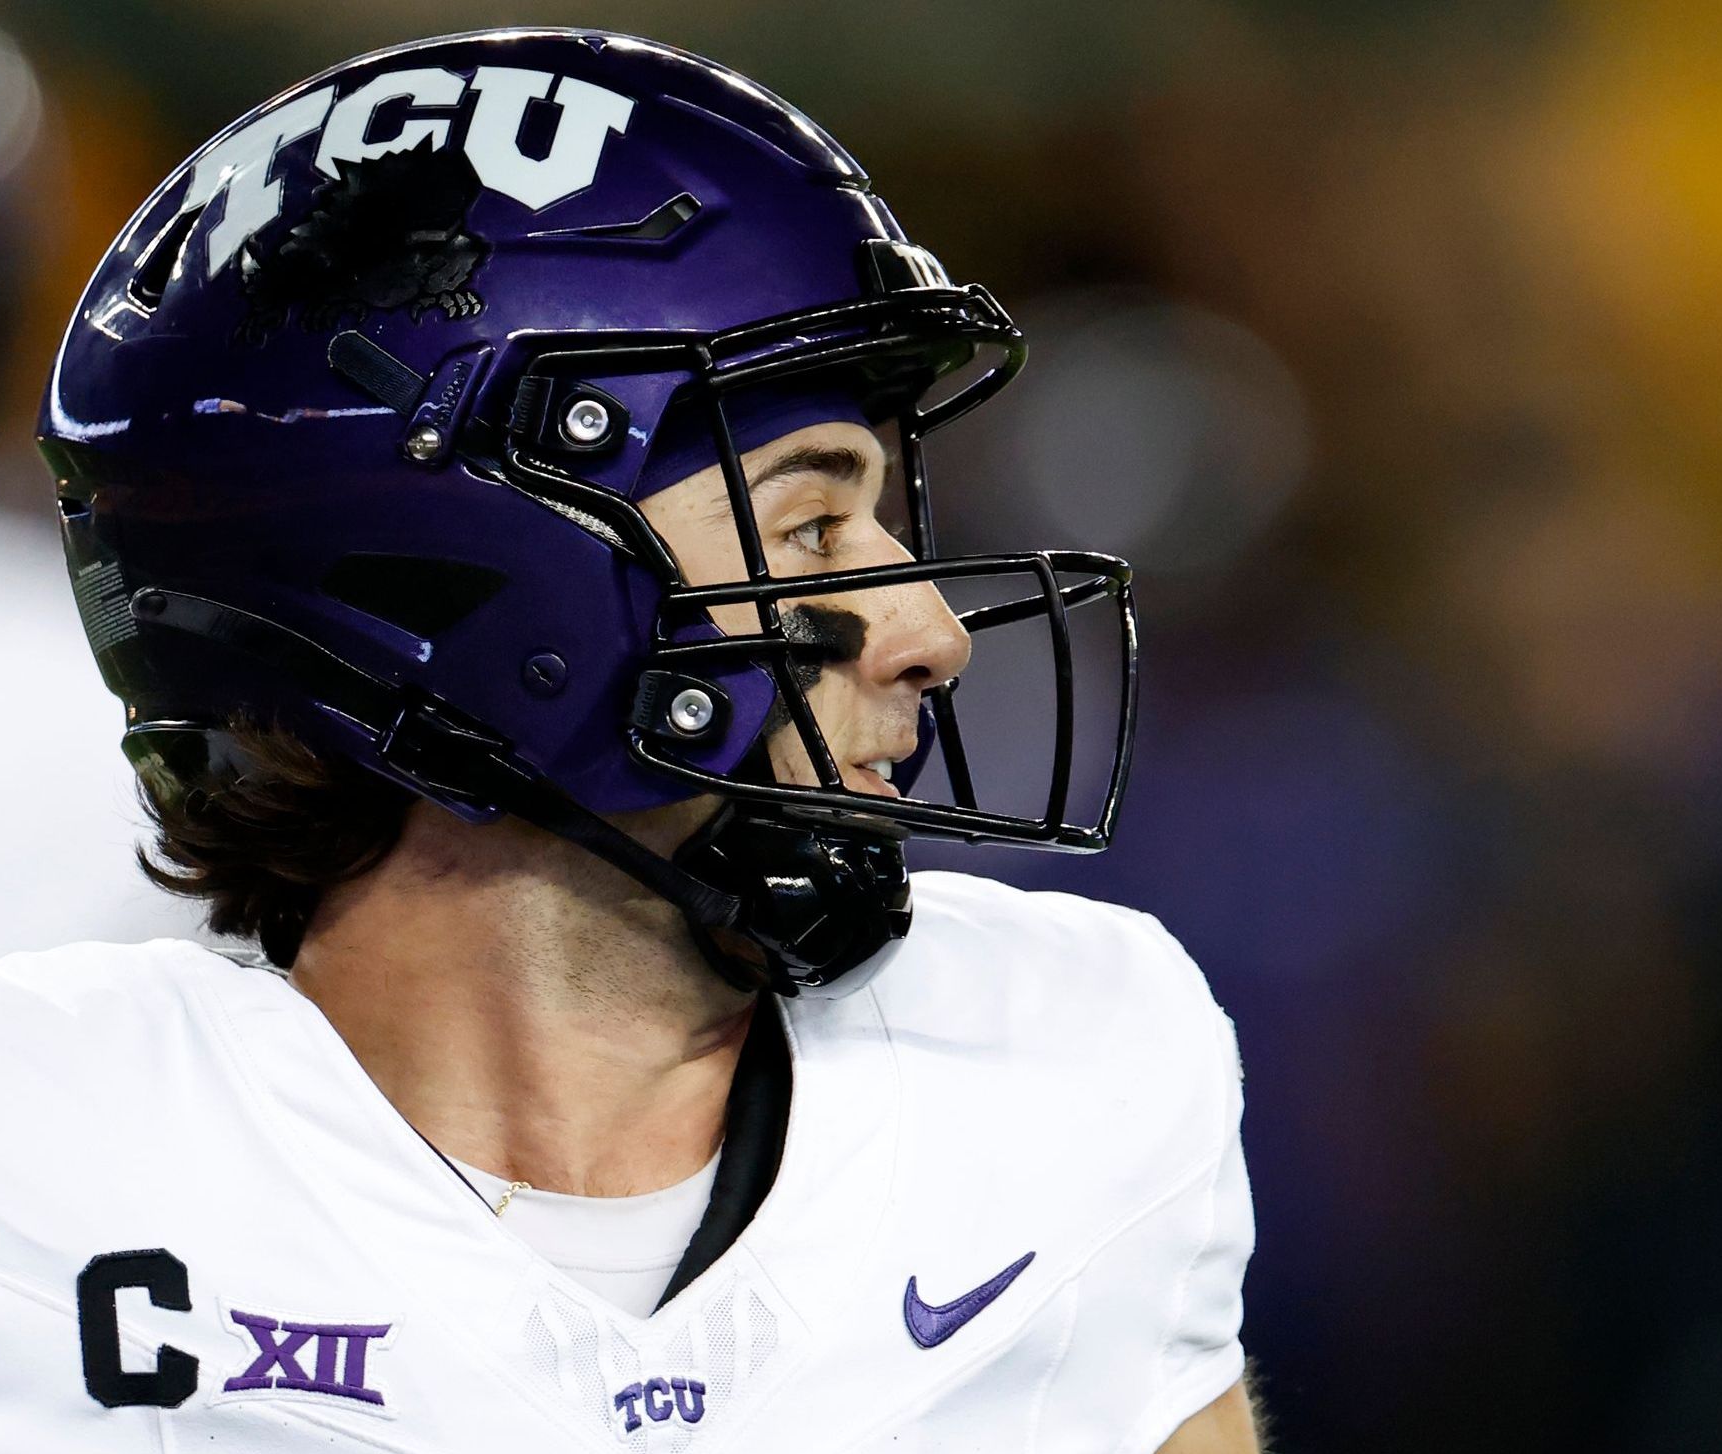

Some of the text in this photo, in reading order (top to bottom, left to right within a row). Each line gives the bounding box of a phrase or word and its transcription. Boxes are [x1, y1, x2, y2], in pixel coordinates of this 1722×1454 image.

[182, 66, 637, 279] TCU
[77, 1247, 199, 1408] C
[223, 1309, 393, 1406] XII
[614, 1376, 706, 1433] TCU
